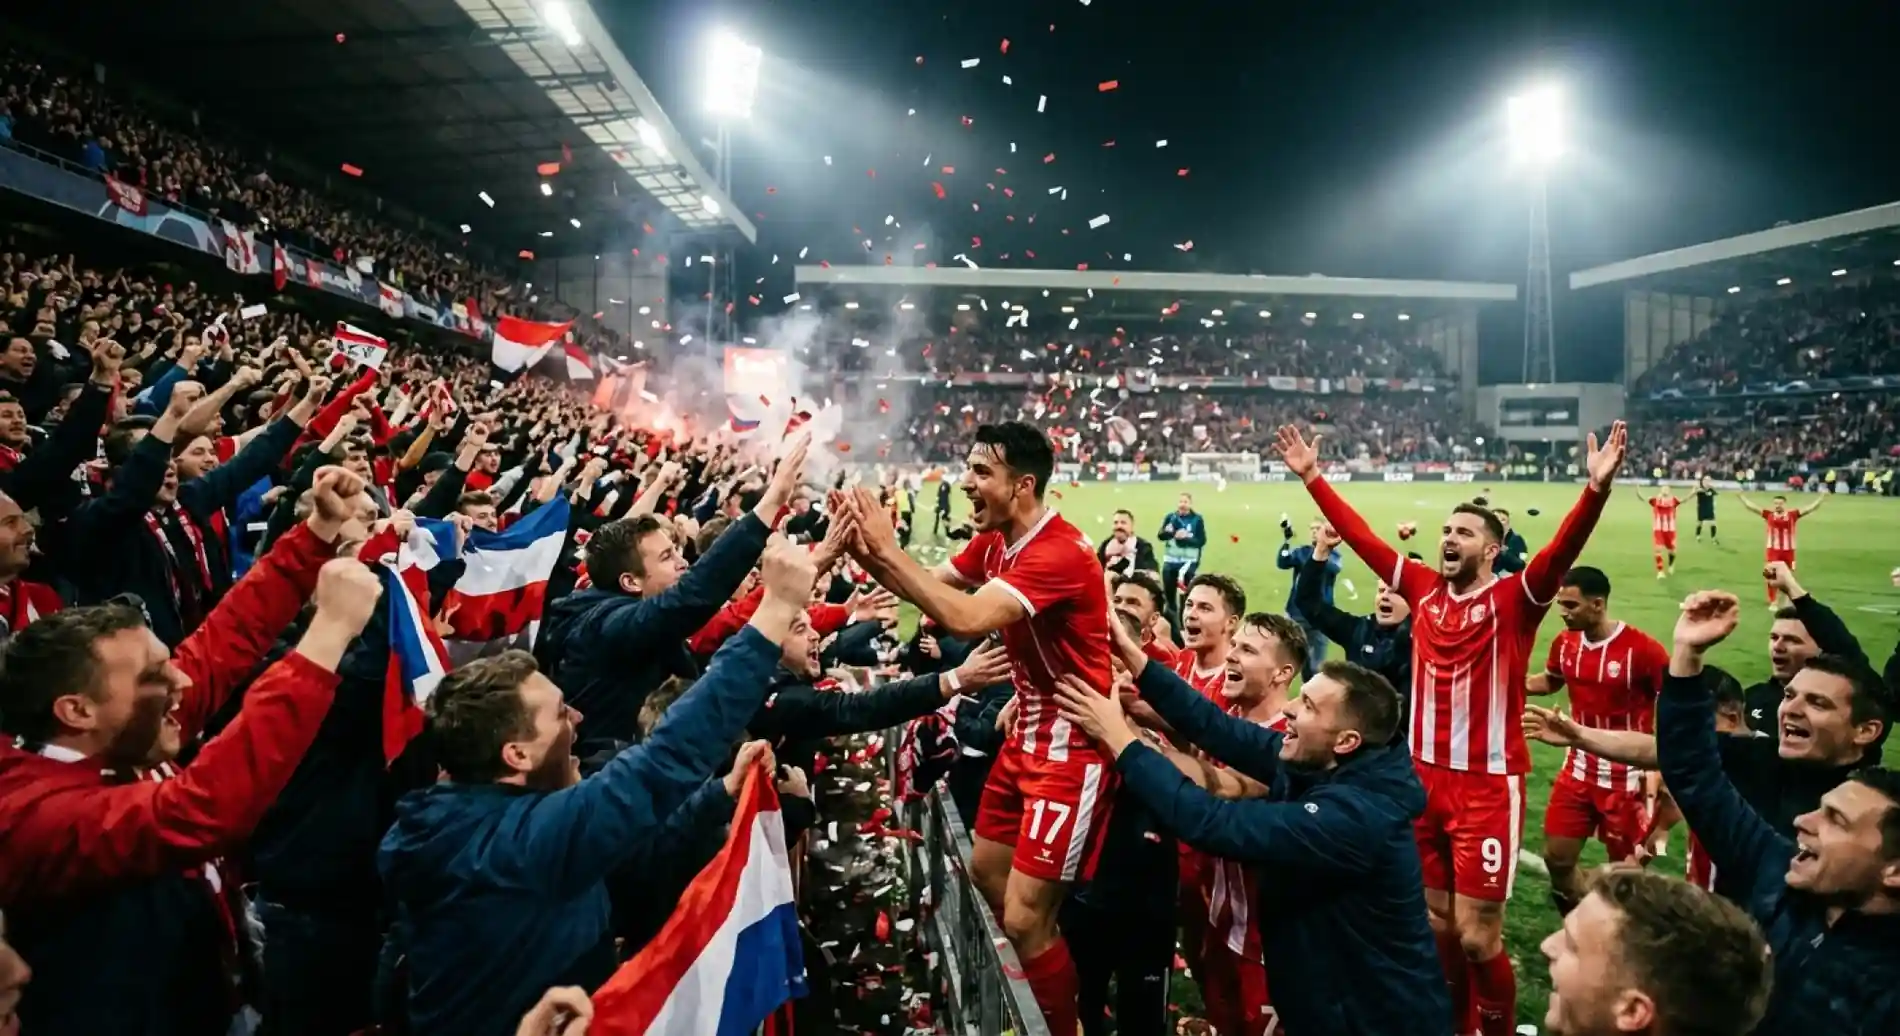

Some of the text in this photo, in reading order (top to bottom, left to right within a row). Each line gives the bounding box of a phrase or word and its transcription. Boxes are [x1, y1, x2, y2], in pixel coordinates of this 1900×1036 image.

[1028, 799, 1071, 845] 17
[1481, 837, 1502, 874] 9
[1260, 1005, 1280, 1036] 7
